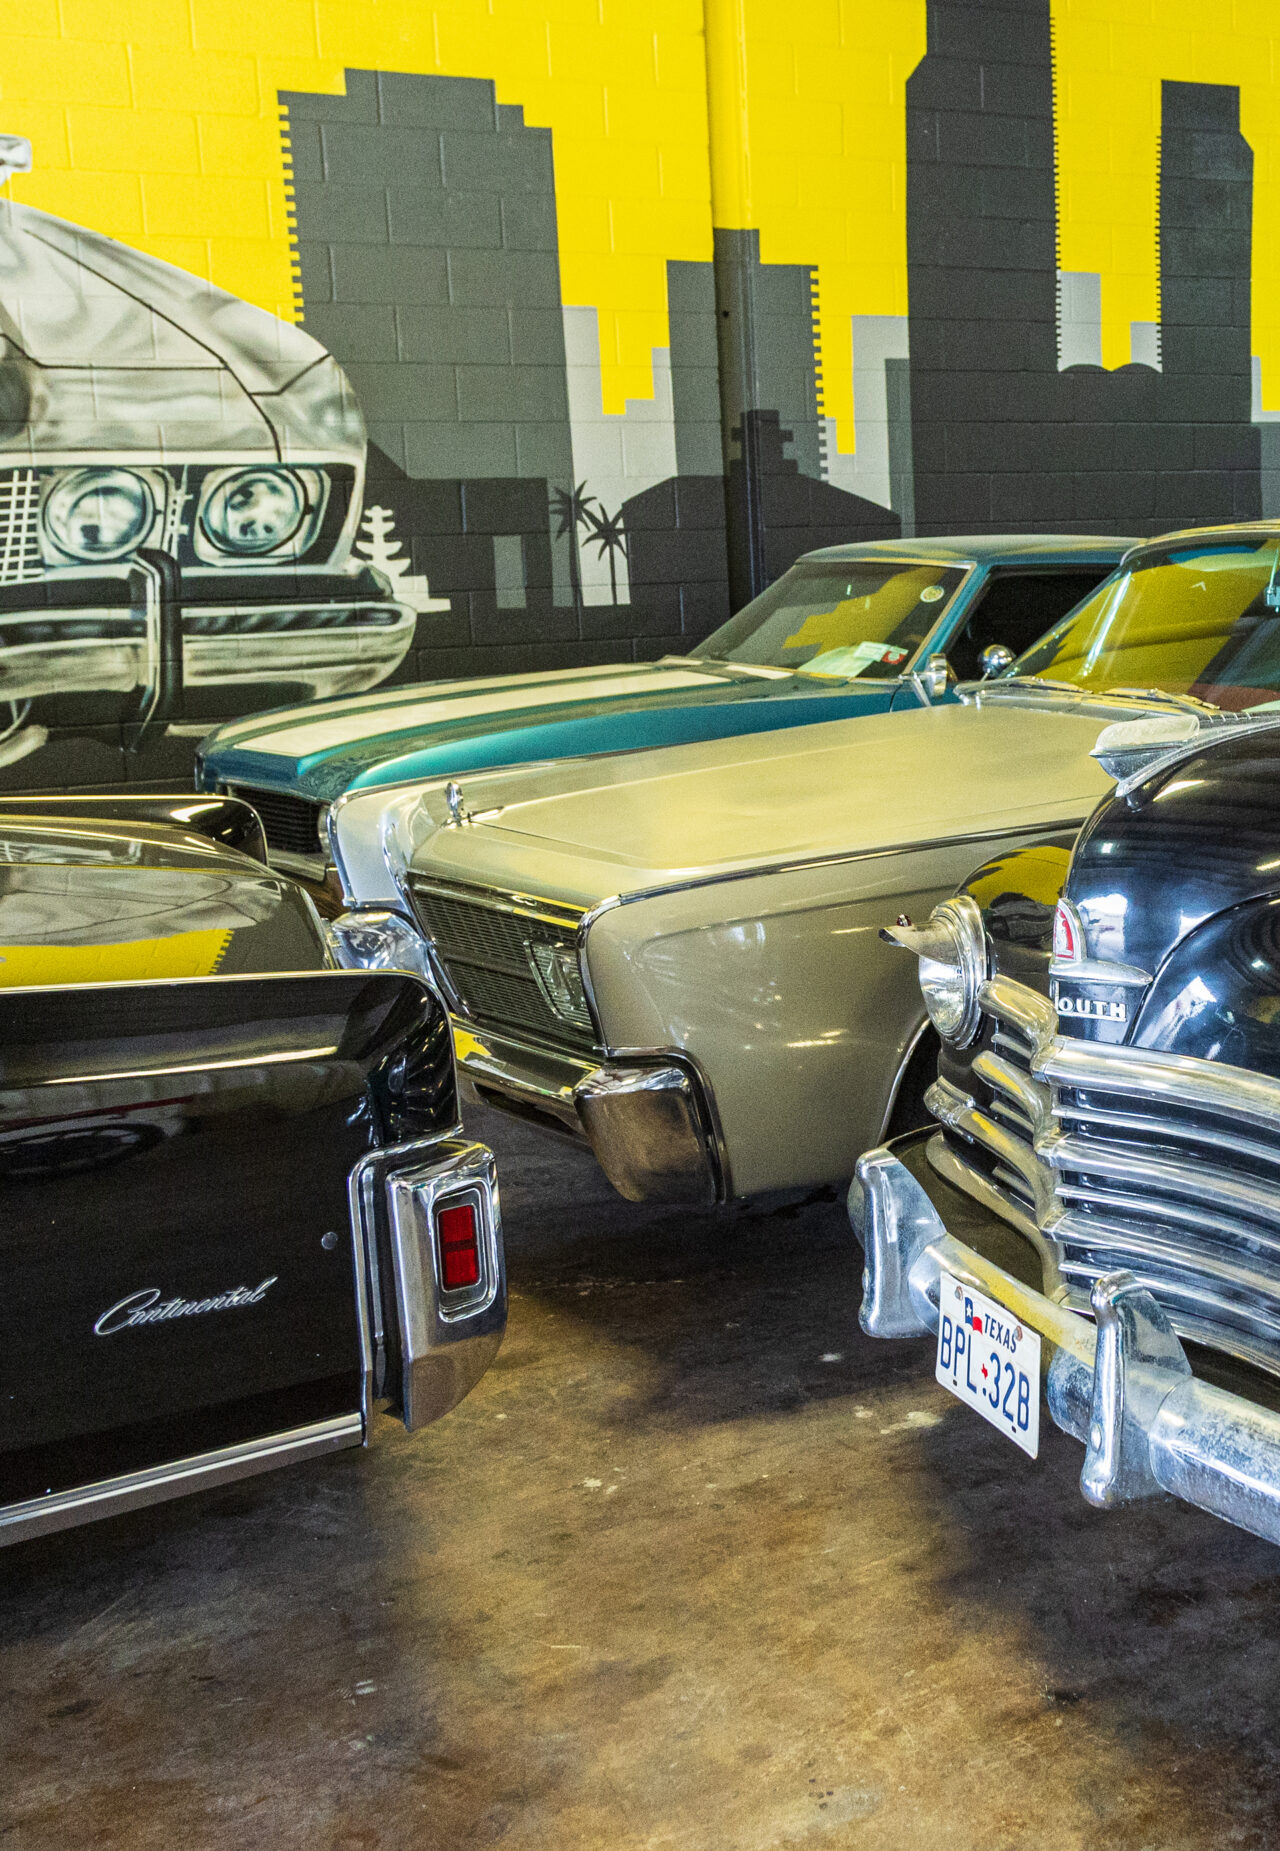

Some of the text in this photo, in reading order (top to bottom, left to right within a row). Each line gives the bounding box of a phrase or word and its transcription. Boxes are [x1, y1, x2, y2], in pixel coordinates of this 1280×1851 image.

[1058, 996, 1127, 1019] OUTH
[93, 1276, 279, 1336] Continental
[984, 1312, 1018, 1353] TEXAS
